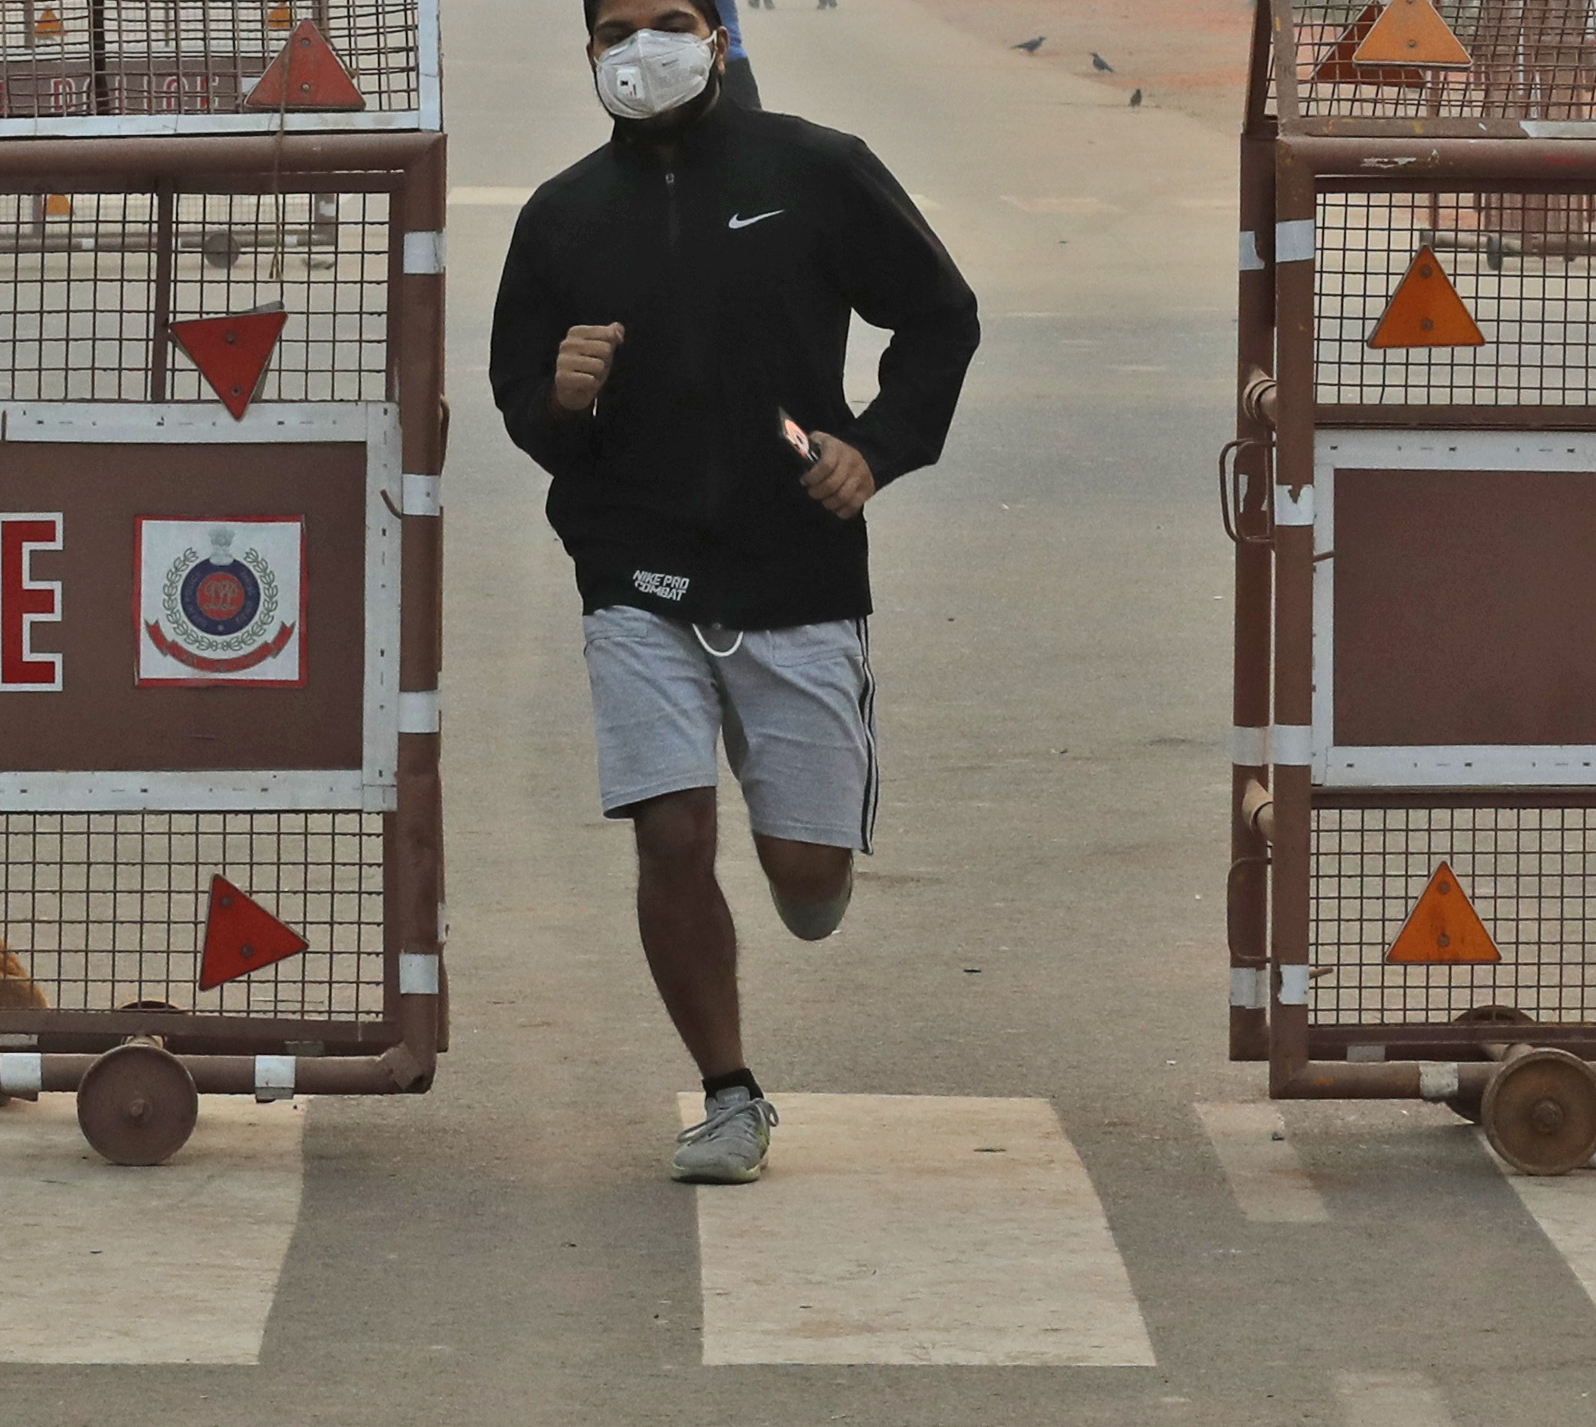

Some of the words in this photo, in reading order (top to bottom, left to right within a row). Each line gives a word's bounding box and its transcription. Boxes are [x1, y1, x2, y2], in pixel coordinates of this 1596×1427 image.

[633, 570, 663, 585] NIKE
[663, 575, 690, 590] PRO
[634, 580, 686, 601] COMBAT
